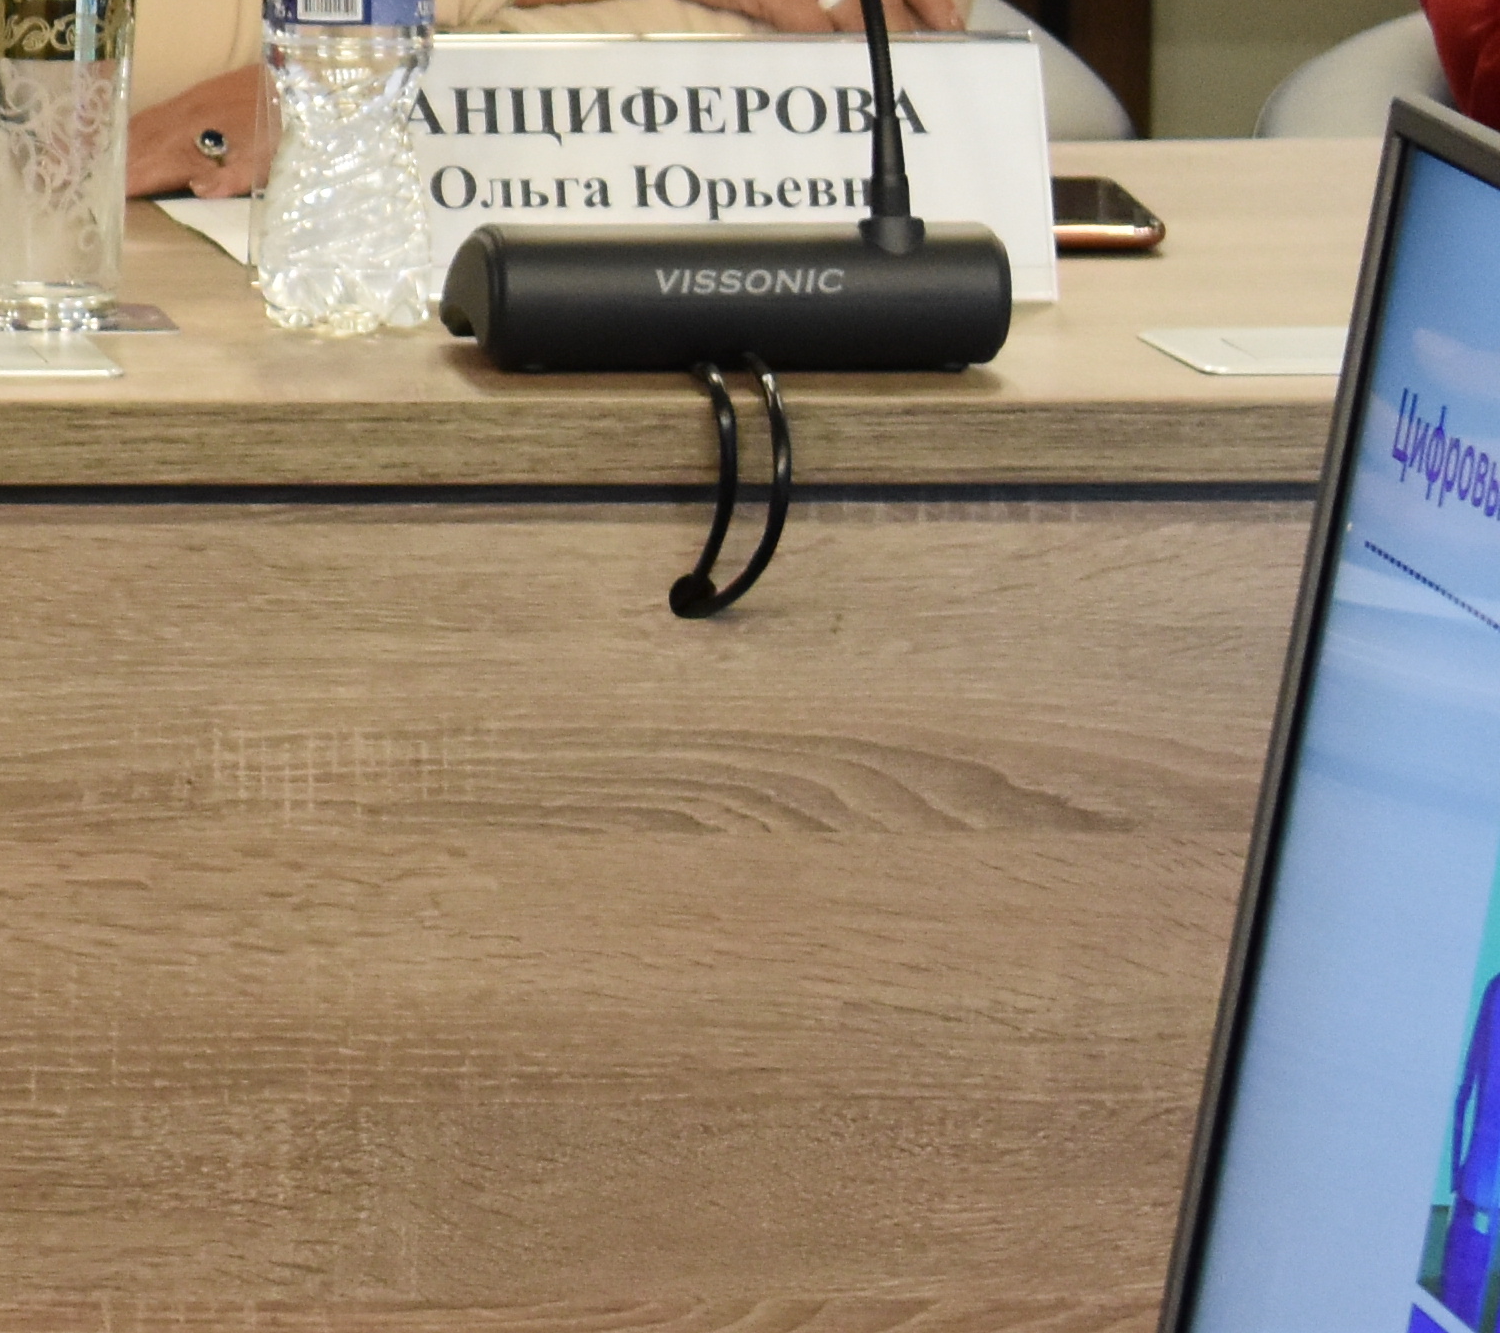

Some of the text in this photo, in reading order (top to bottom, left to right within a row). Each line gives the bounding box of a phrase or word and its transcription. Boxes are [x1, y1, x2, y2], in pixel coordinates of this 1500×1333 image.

[406, 85, 931, 146] АНЦИФЕРОВА
[429, 163, 873, 221] Ольга Юрьевн
[655, 267, 846, 295] VISSONIC
